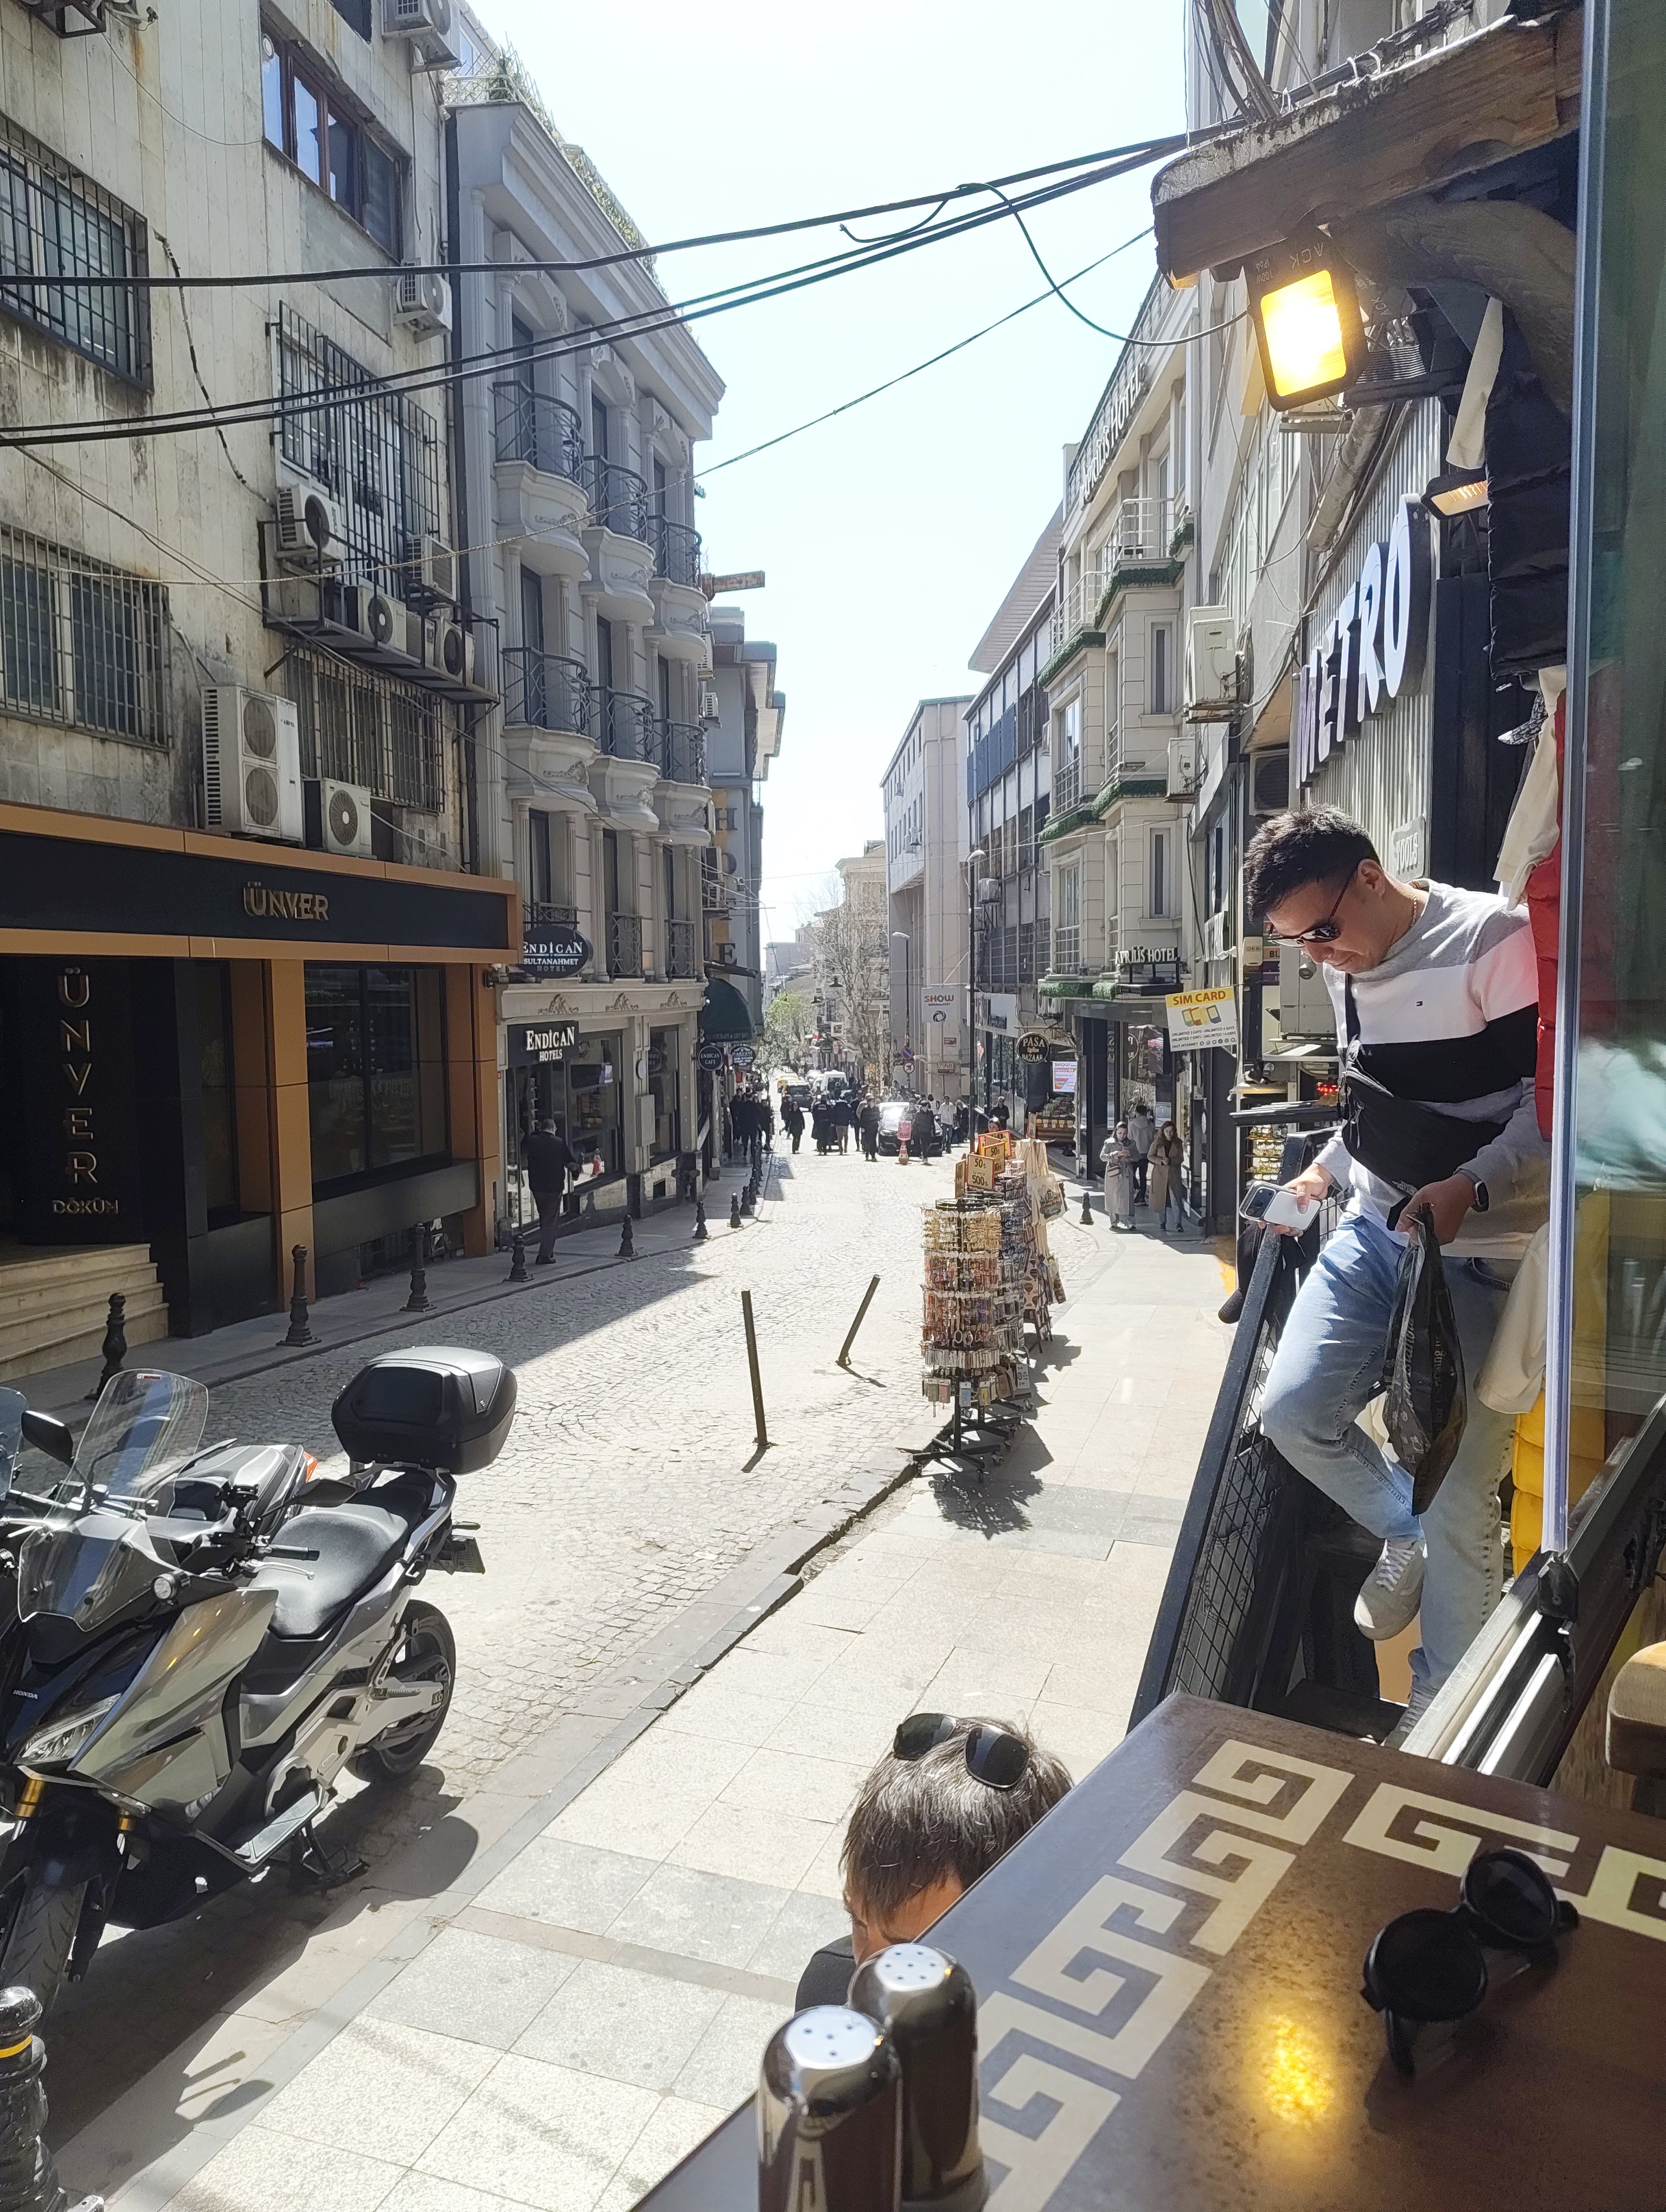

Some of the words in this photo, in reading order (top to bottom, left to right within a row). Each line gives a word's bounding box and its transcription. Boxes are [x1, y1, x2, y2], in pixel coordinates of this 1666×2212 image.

[1111, 363, 1141, 449] HOTEL
[1296, 493, 1421, 789] METRO
[244, 881, 329, 921] ÜNVER
[1146, 948, 1177, 963] HOTEL
[924, 994, 954, 1002] SHOW
[1172, 994, 1193, 1006] SIM
[1195, 990, 1226, 1002] CARD
[539, 1049, 562, 1062] HOTELS
[13, 1689, 38, 1700] HONDA
